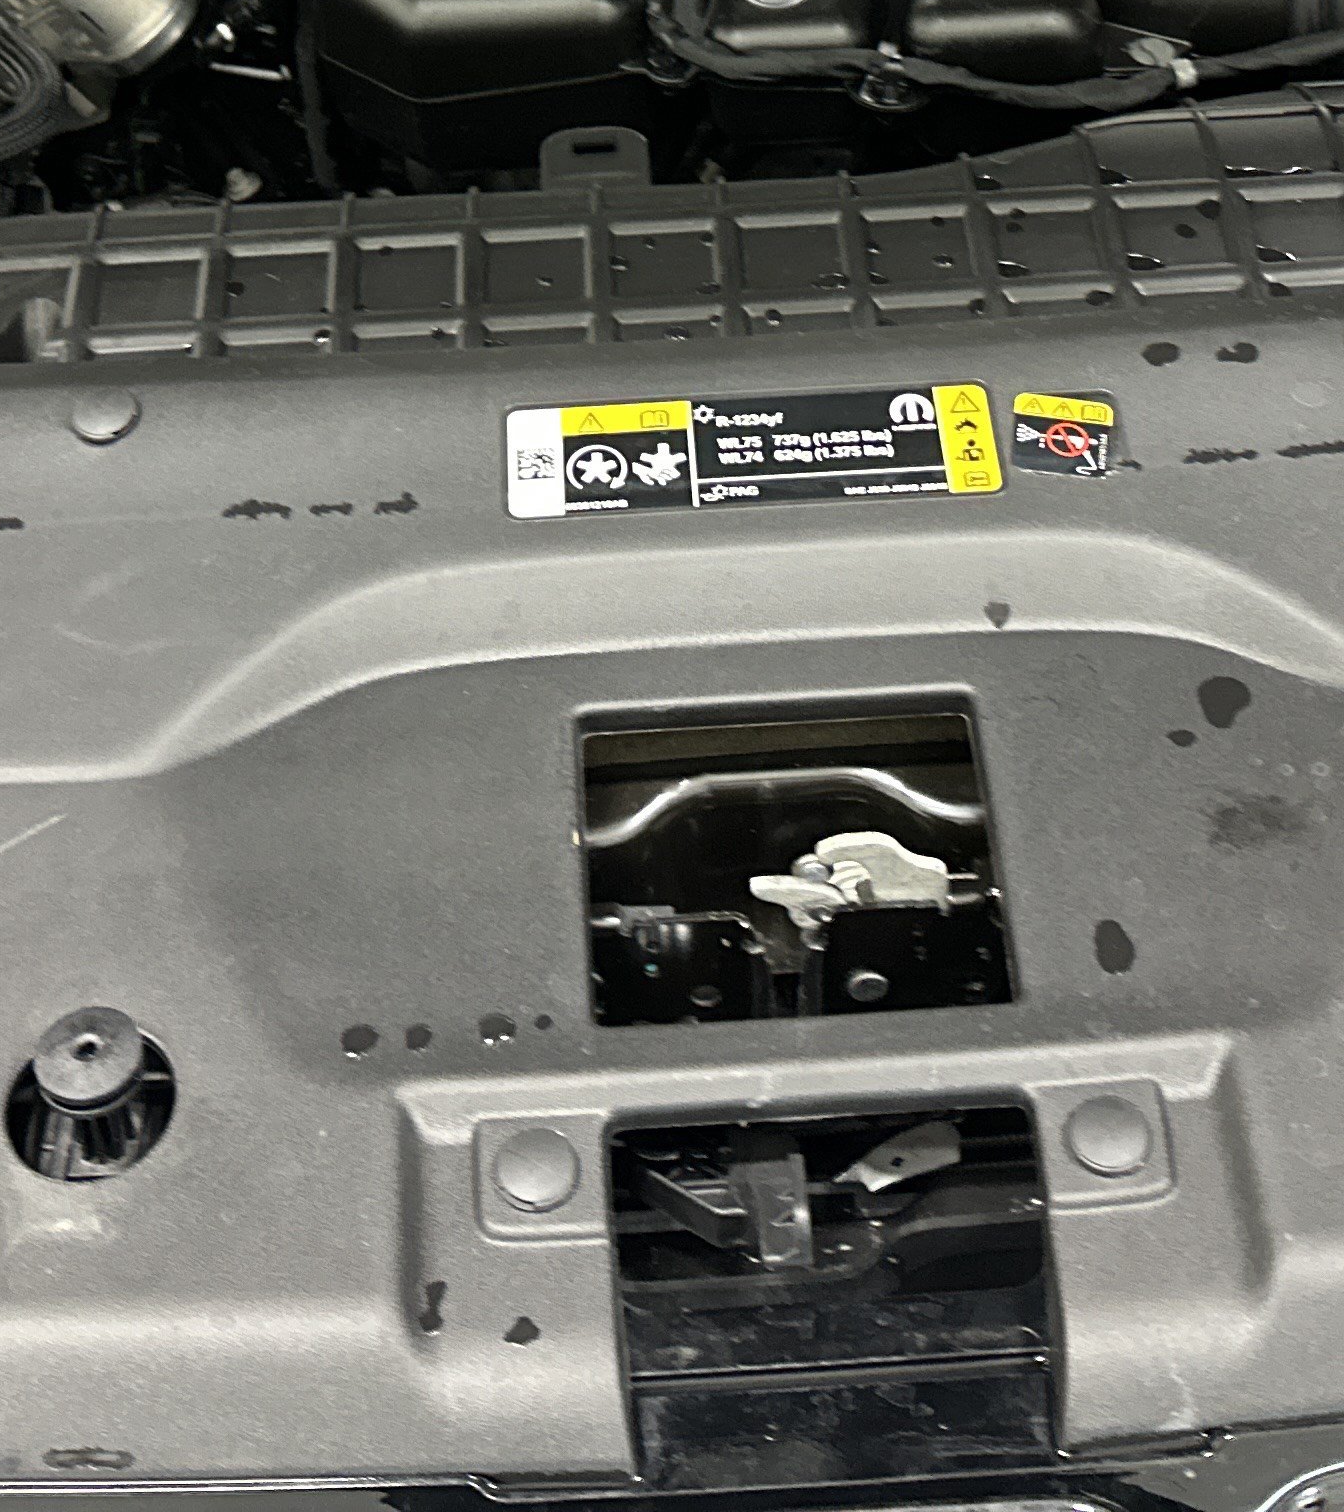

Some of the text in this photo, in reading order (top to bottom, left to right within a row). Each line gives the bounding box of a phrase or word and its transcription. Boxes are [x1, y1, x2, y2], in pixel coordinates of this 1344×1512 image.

[716, 412, 783, 427] R-1234yf
[716, 429, 892, 449] WL75 737g (1.625 lbs)
[718, 451, 764, 465] WL74
[814, 446, 862, 462] (1.375
[863, 444, 895, 458] lbs)
